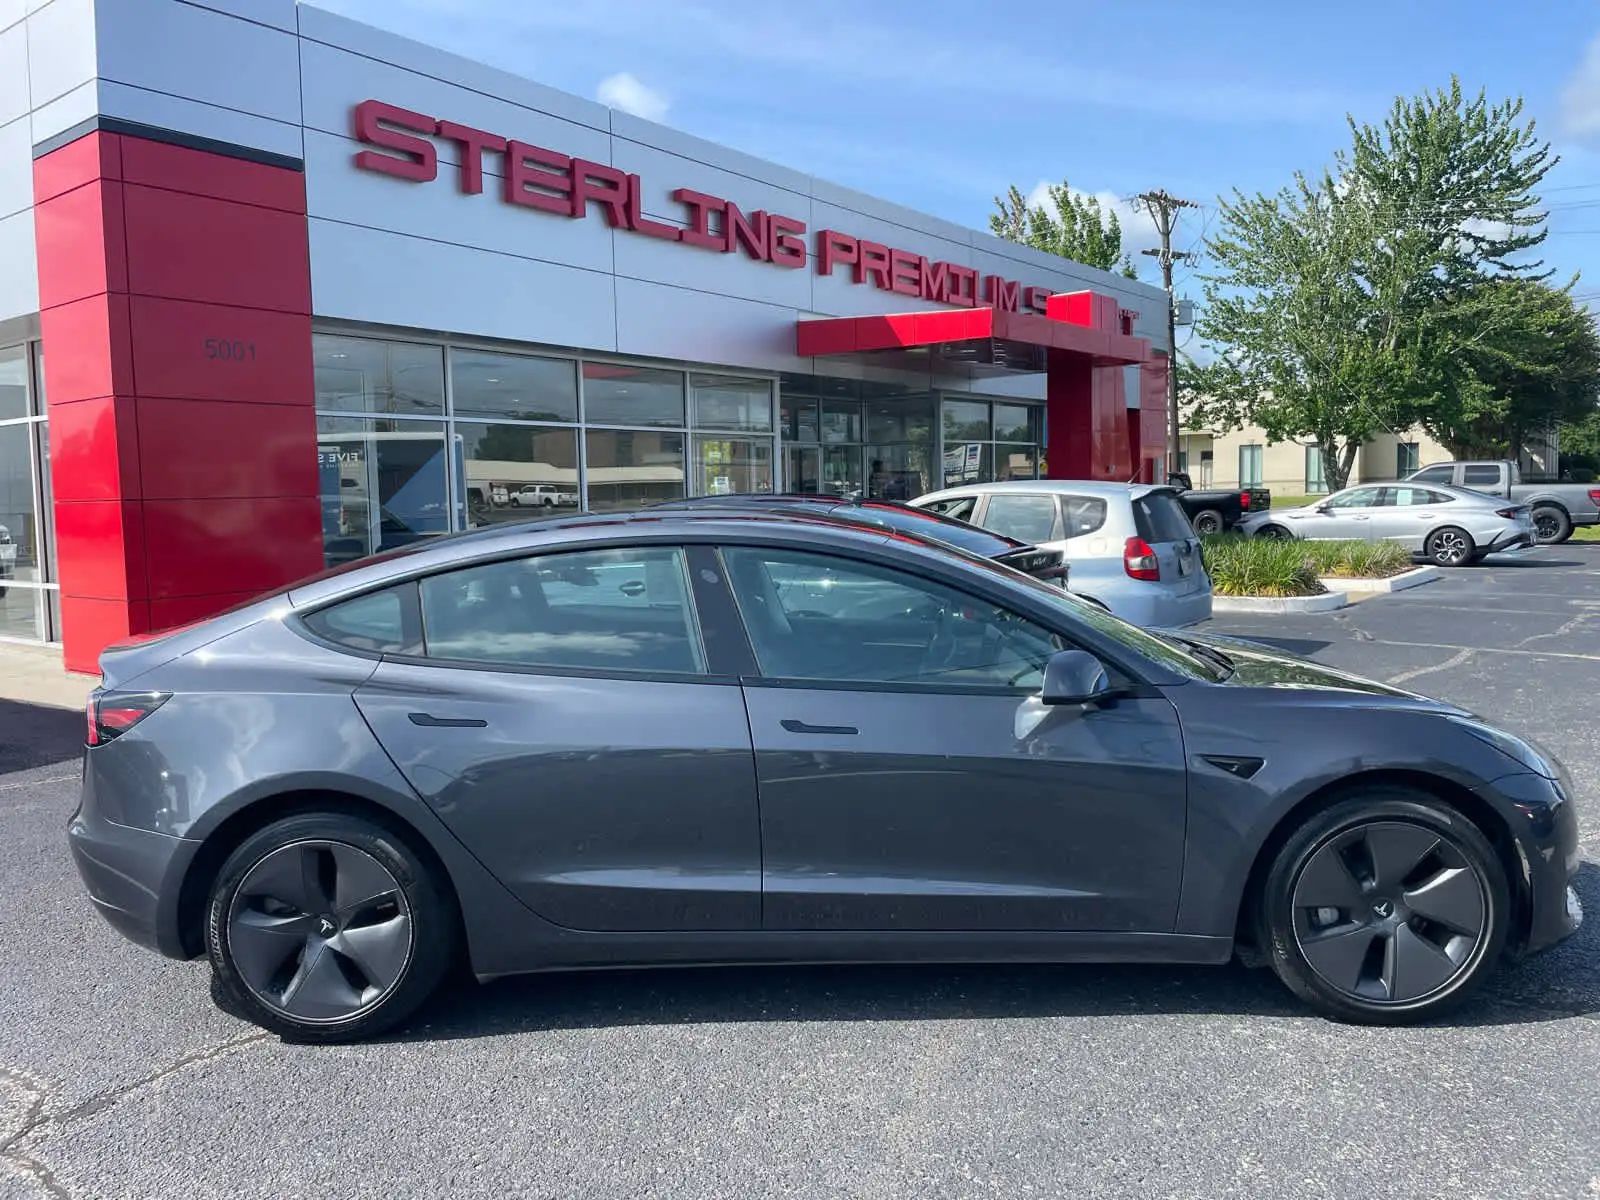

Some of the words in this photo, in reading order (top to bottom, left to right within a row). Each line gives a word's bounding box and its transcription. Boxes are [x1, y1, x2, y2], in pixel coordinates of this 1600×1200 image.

[355, 100, 806, 269] STERLING
[818, 229, 1020, 313] PREMIUM
[204, 338, 255, 362] 5001
